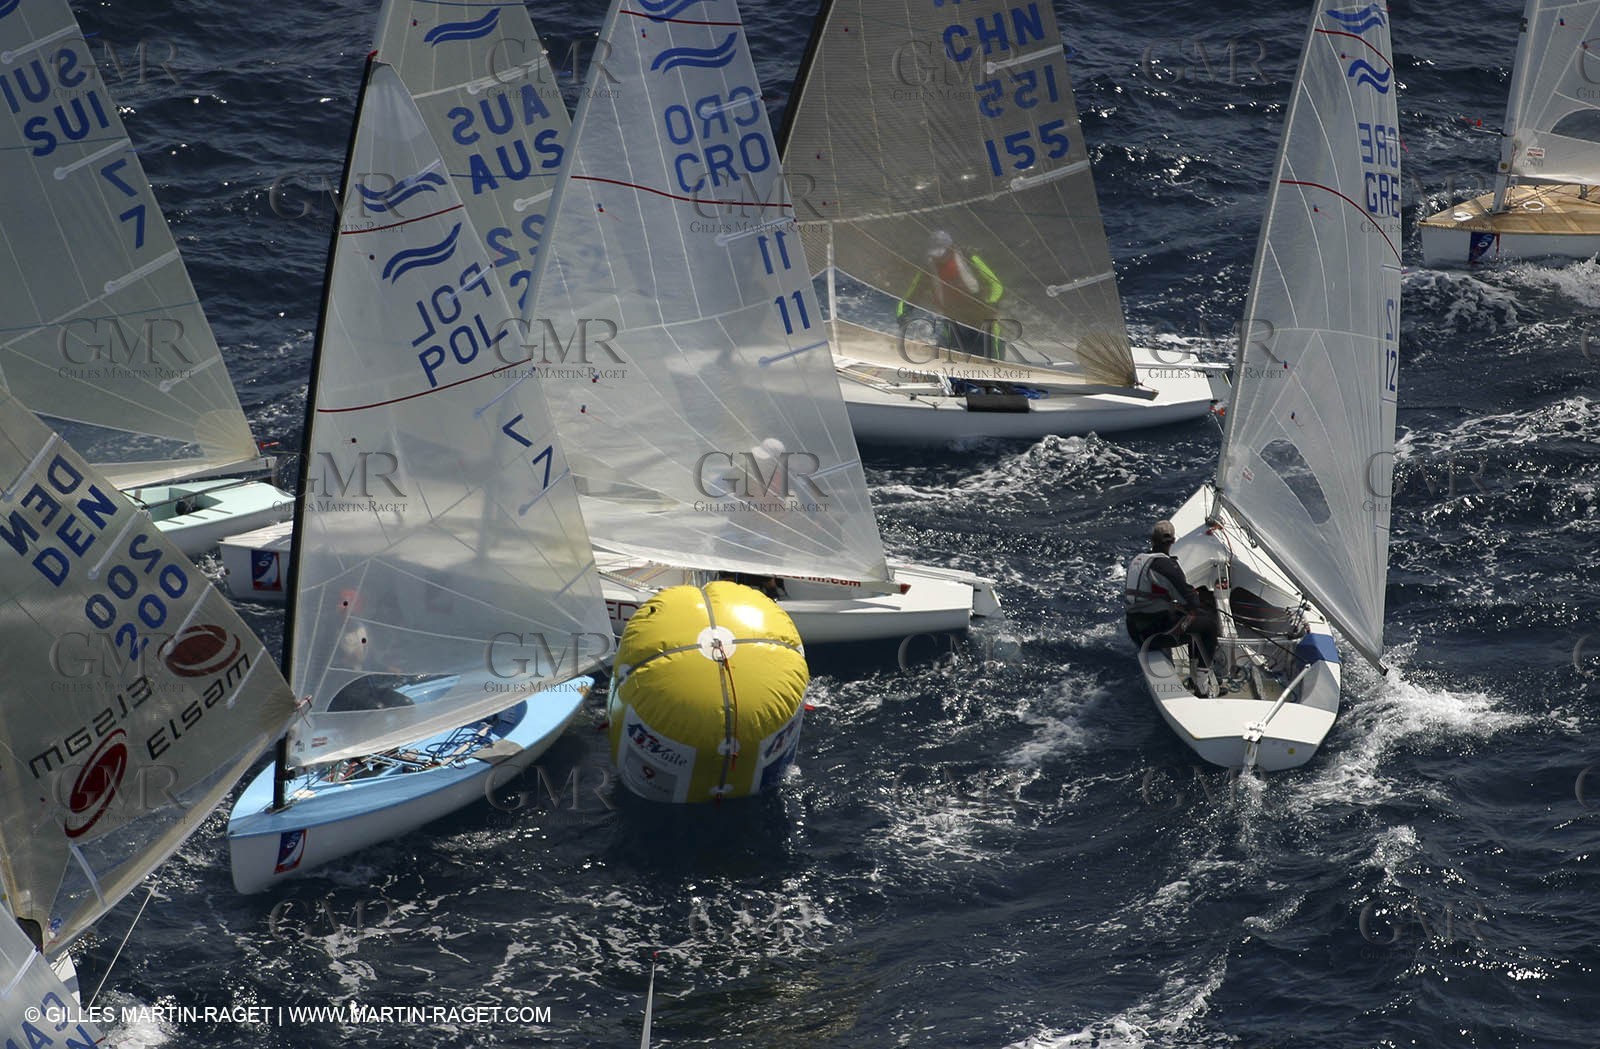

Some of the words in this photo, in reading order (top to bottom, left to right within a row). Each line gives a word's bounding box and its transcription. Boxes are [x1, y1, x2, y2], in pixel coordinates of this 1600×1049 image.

[943, 2, 1046, 62] CHN
[24, 92, 110, 157] SUI
[984, 119, 1070, 177] 155
[469, 129, 564, 195] AUS
[674, 132, 771, 193] CRO
[1365, 171, 1400, 218] GRE
[119, 204, 146, 249] 7
[773, 290, 811, 335] 11
[418, 313, 509, 389] POL
[1385, 348, 1397, 392] 12
[532, 445, 553, 491] 7
[32, 485, 118, 587] DEN
[115, 563, 188, 662] 200
